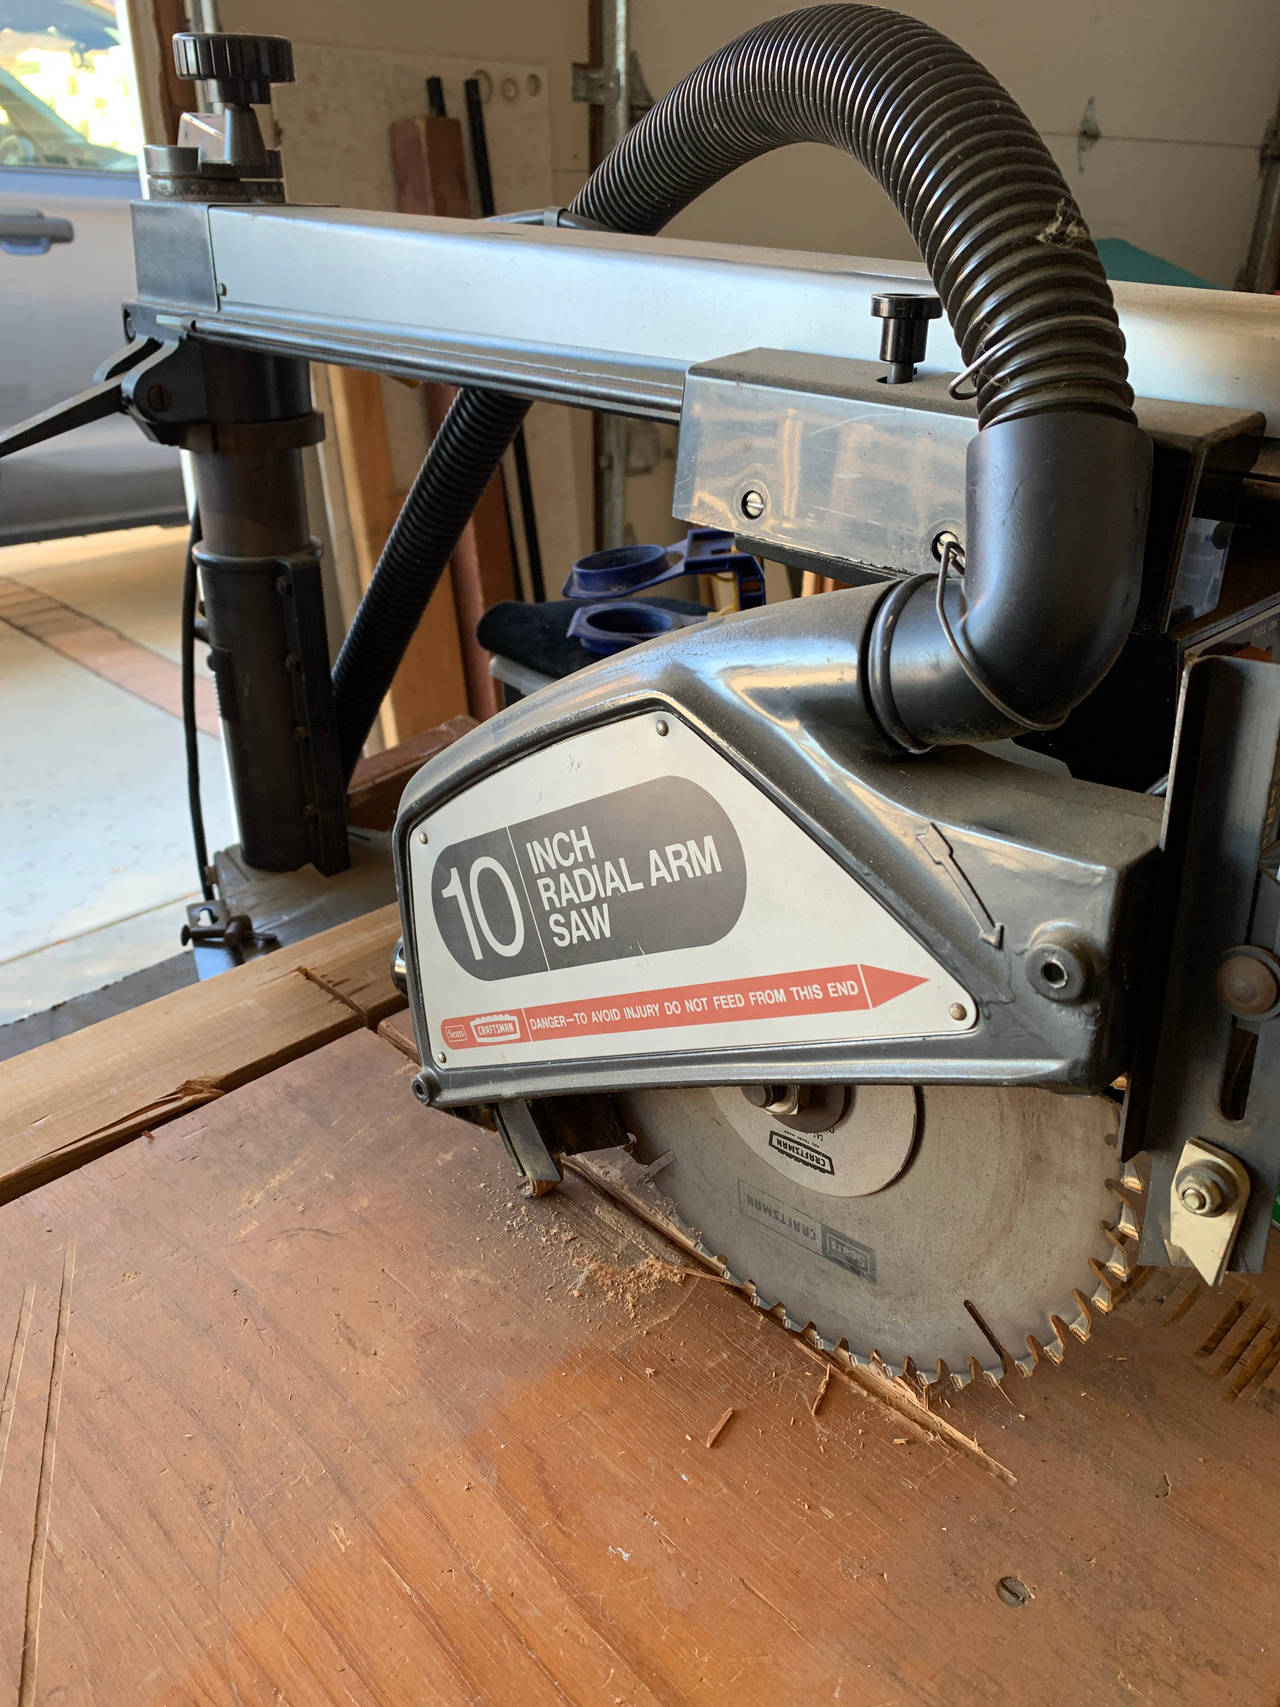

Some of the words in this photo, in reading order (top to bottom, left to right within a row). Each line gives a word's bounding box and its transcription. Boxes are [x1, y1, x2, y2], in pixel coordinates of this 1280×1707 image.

[526, 825, 596, 875] INCH
[536, 857, 644, 911] RADIAL
[649, 835, 722, 887] ARM
[441, 856, 525, 961] 10
[548, 903, 613, 947] SAW
[591, 1008, 621, 1024] AVOID
[623, 1004, 661, 1020] INJURY
[664, 1001, 681, 1016] DO
[685, 997, 708, 1013] NOT
[713, 993, 745, 1010] FEED
[748, 989, 787, 1006] FROM
[790, 984, 823, 1001] THIS
[827, 980, 859, 998] END
[477, 1022, 515, 1036] CRAFTSMAN
[776, 1138, 826, 1167] CRAFTSMAN
